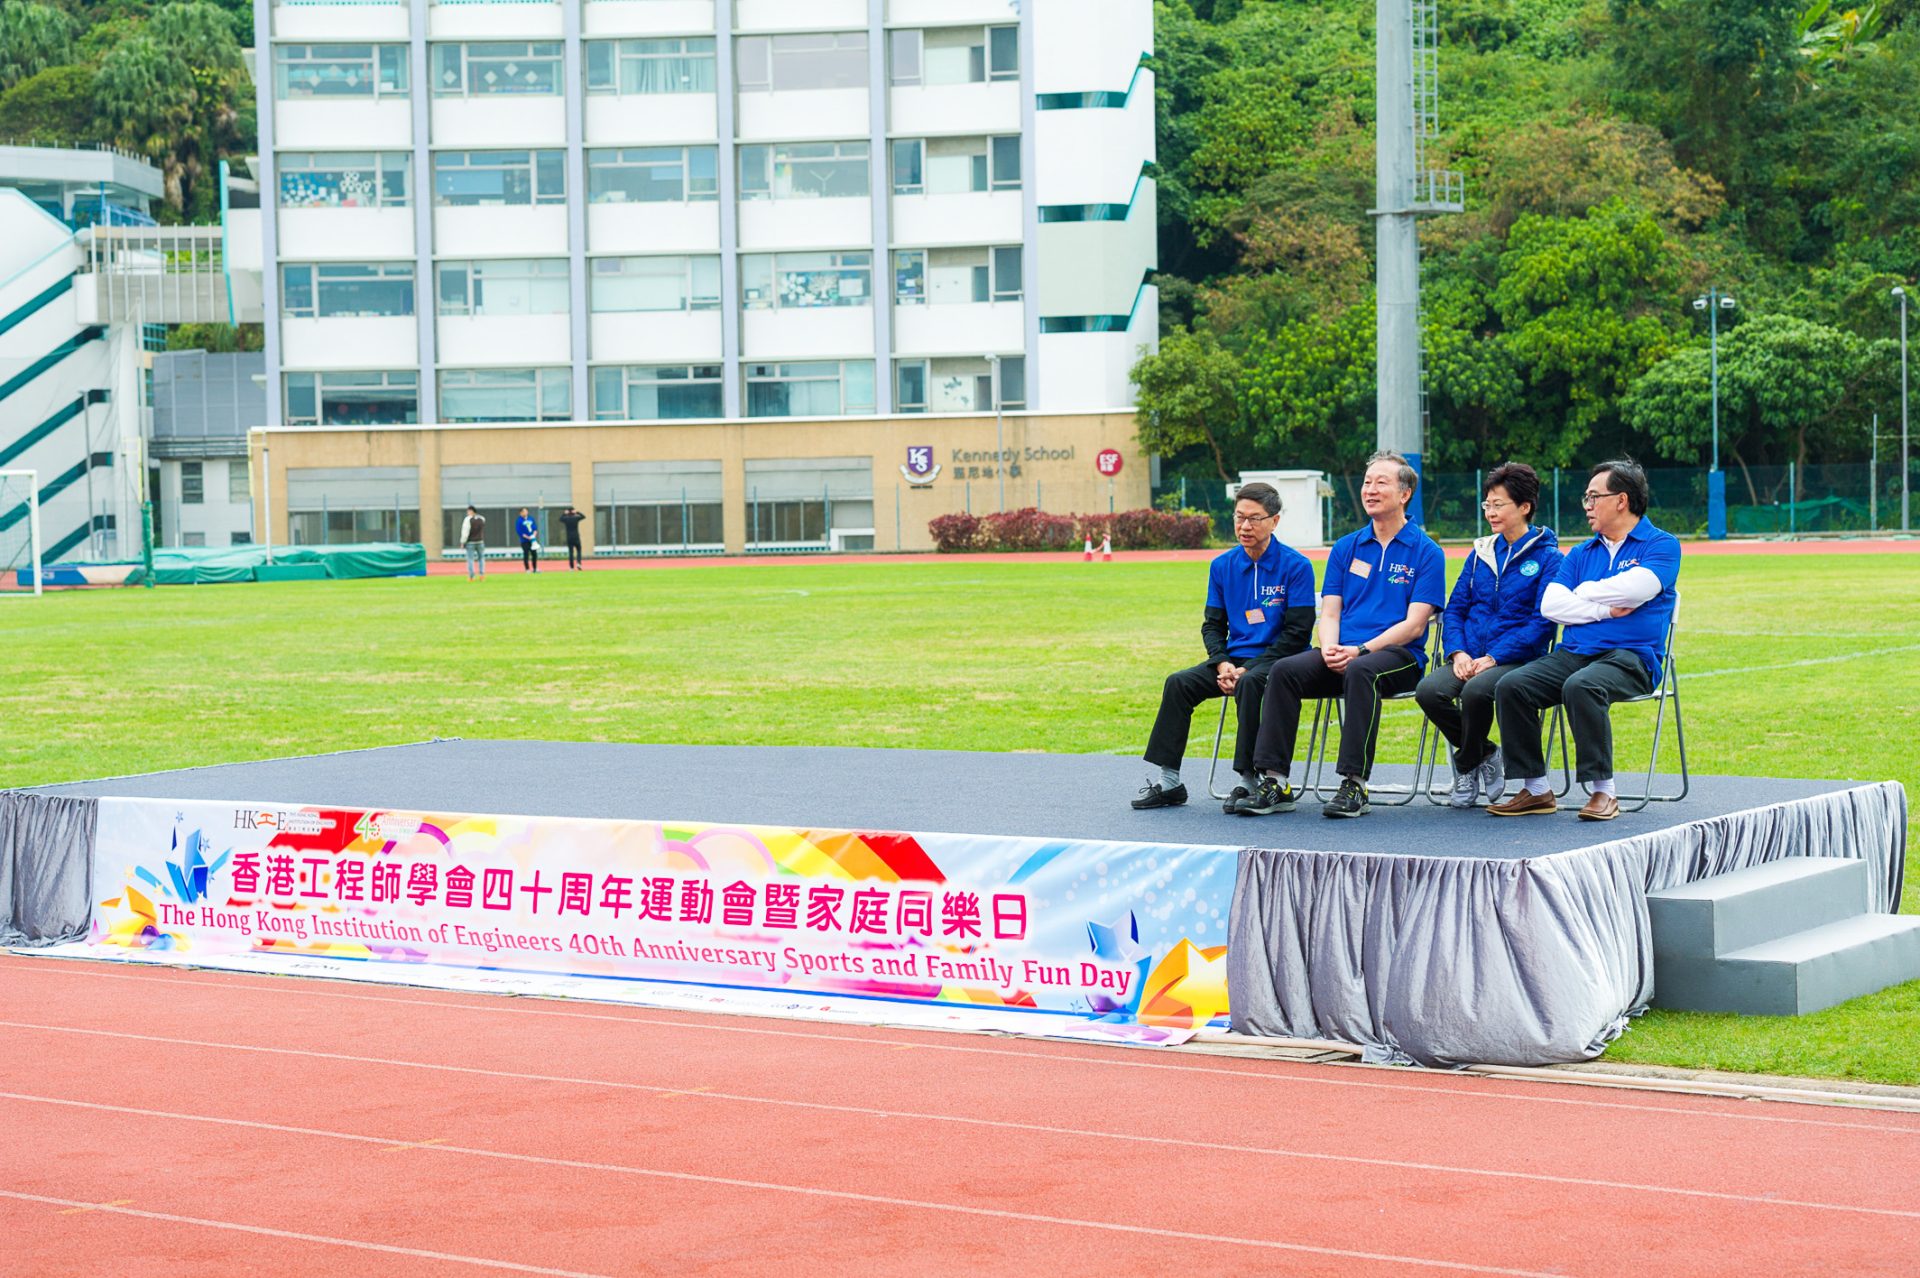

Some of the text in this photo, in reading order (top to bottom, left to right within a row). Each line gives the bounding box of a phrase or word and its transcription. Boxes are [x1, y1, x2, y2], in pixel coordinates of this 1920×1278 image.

[952, 445, 1075, 465] Kennedy School
[1100, 454, 1119, 465] ESF
[231, 852, 1029, 941] 香港工程師學會四十周年運動會暨家庭同樂日
[160, 903, 1133, 997] The Hong Kong Institution of Engineers 40th Anniversary Sports and Family Fun Day
